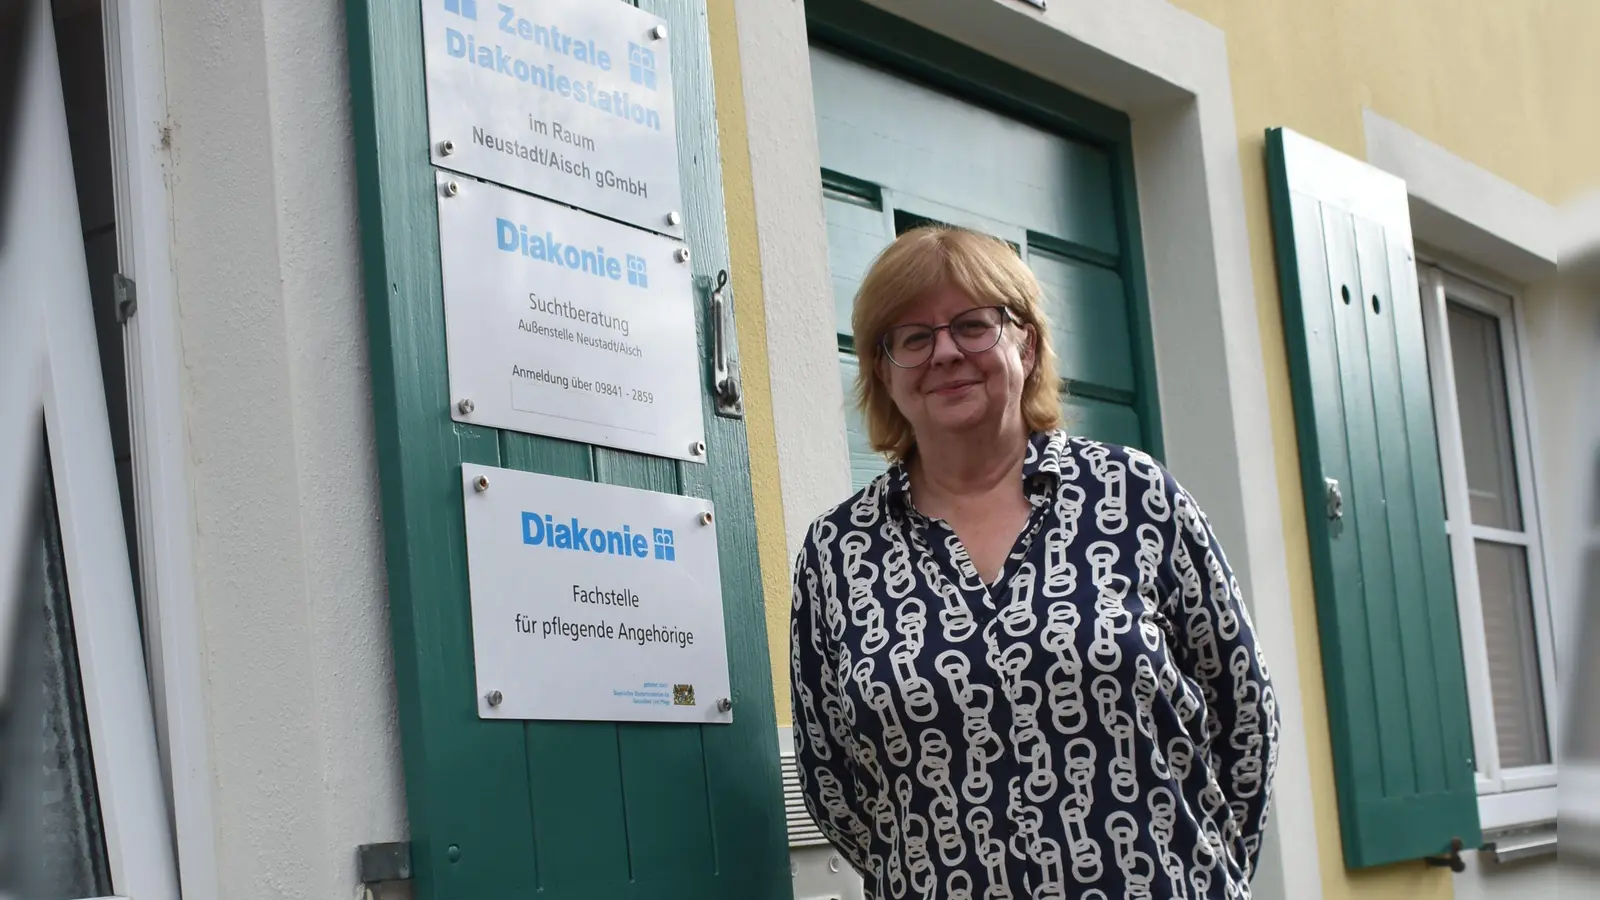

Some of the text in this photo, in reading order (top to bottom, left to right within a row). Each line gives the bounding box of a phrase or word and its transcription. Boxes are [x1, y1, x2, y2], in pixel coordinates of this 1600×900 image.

[499, 5, 612, 71] Zentrale
[446, 28, 660, 131] Diakoniestation
[528, 113, 595, 151] im Raum
[472, 126, 648, 199] Neustadt/Aisch gGmbH
[496, 217, 622, 280] Diakonie
[529, 293, 629, 336] Suchtberatung
[518, 318, 643, 358] Außenstelle Neustadt/Aisch
[512, 364, 569, 390] Anmeldung
[571, 375, 593, 392] über
[595, 381, 623, 398] 09841
[632, 389, 654, 404] 2859
[521, 511, 648, 558] Diakonie
[573, 585, 640, 608] Fachstelle
[515, 613, 694, 649] für pflegende Angehörige
